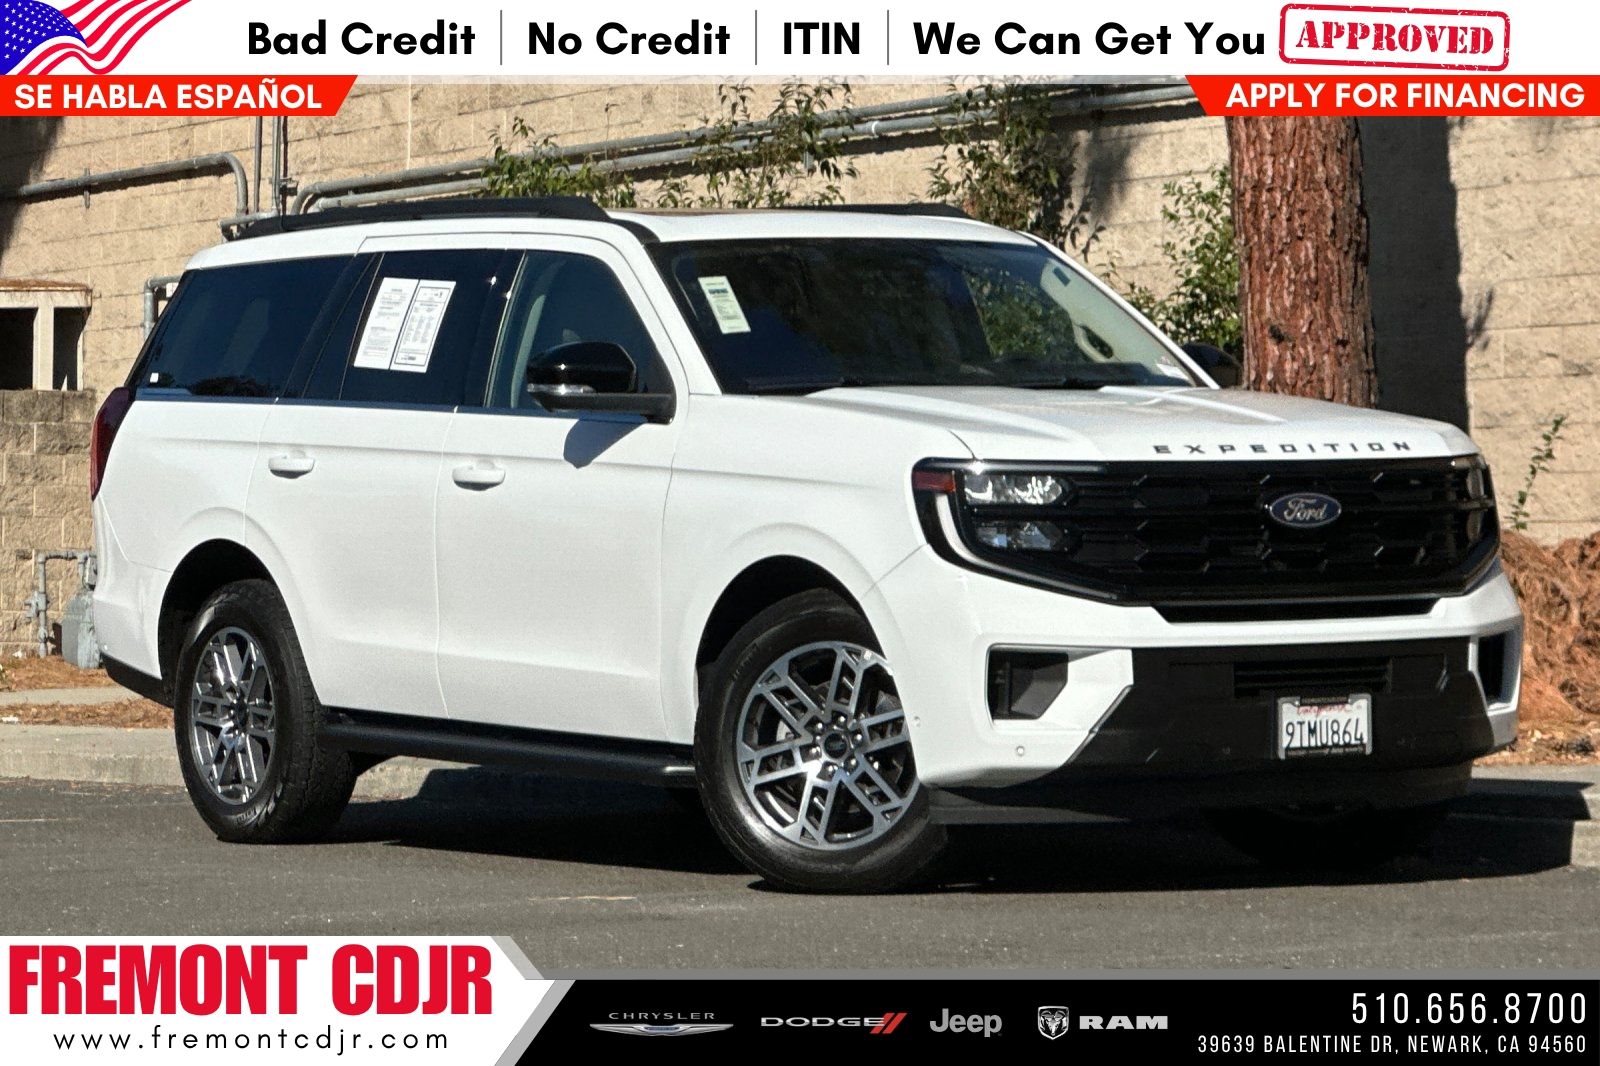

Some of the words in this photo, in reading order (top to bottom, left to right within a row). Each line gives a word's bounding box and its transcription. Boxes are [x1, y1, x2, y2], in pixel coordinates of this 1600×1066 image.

[1152, 441, 1412, 455] EXPEDITION
[1283, 497, 1328, 522] Ford
[1285, 717, 1365, 748] 9TMU864
